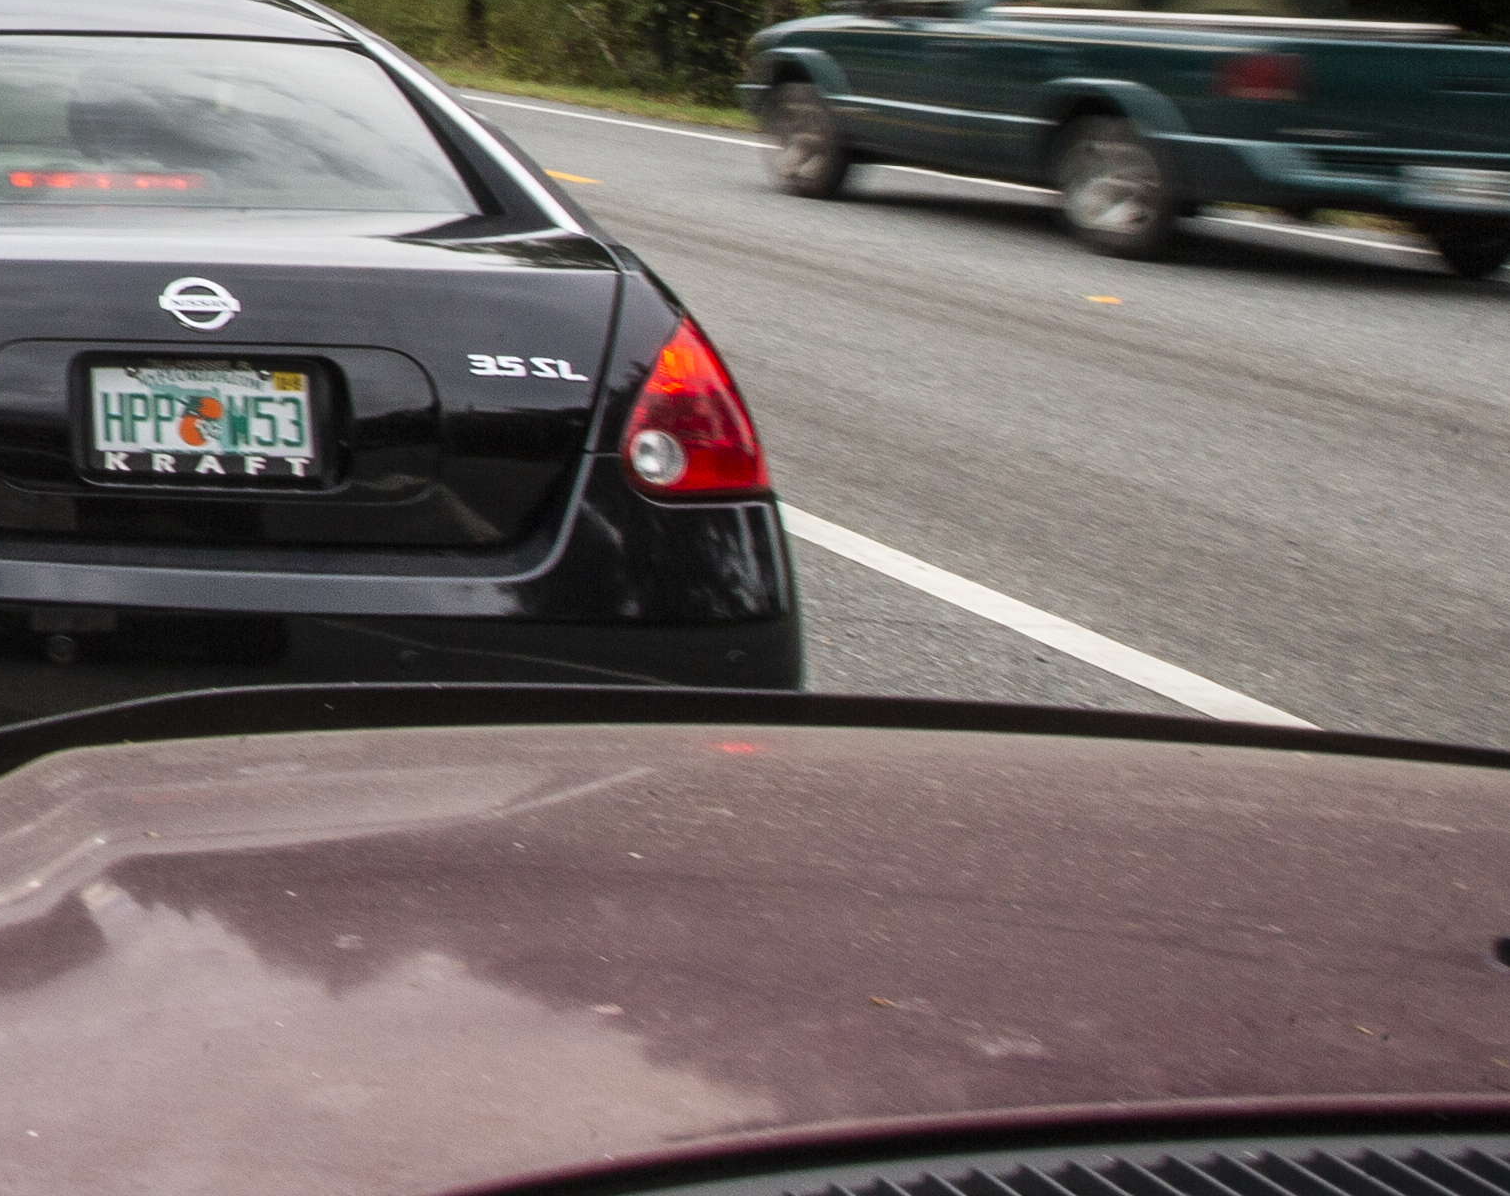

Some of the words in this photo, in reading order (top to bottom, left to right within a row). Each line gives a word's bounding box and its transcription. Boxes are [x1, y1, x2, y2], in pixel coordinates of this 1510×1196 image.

[529, 356, 590, 382] SL
[100, 392, 176, 444] HPP
[104, 451, 311, 477] KRAFT
